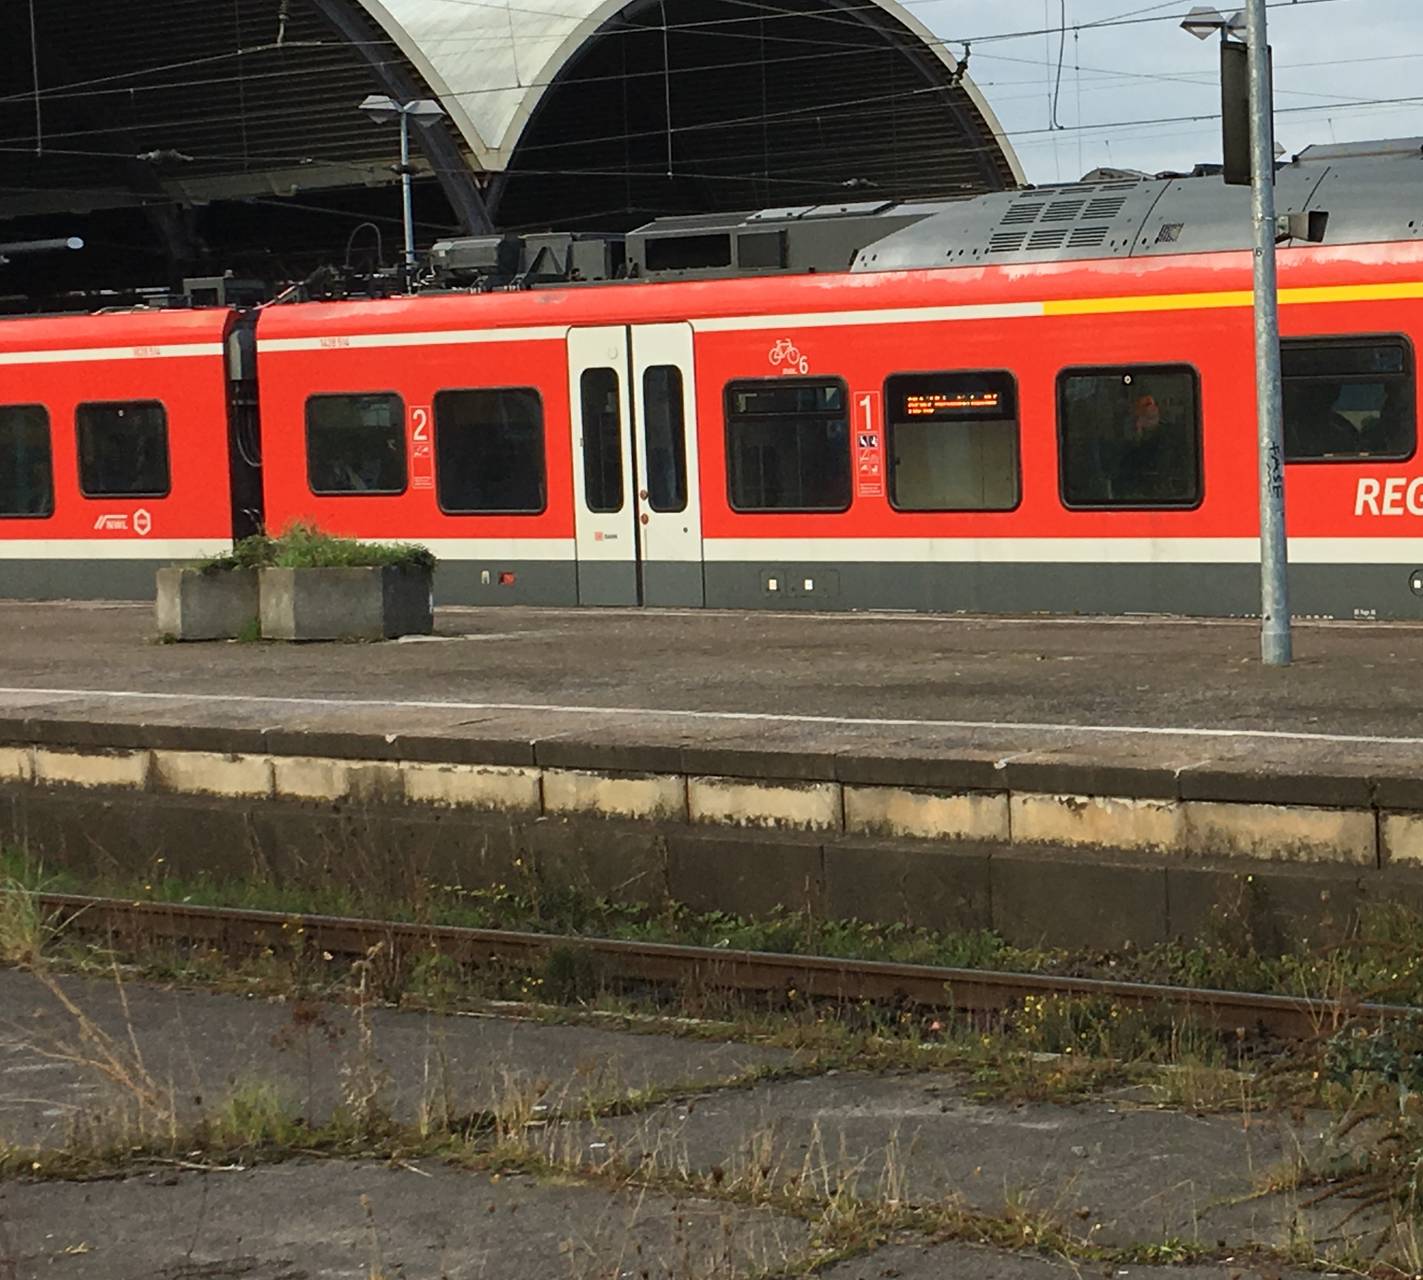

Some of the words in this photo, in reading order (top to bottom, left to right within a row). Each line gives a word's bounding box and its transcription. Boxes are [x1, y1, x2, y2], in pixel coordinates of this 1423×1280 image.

[799, 355, 809, 374] 6
[413, 409, 427, 440] 2
[859, 395, 872, 430] 1
